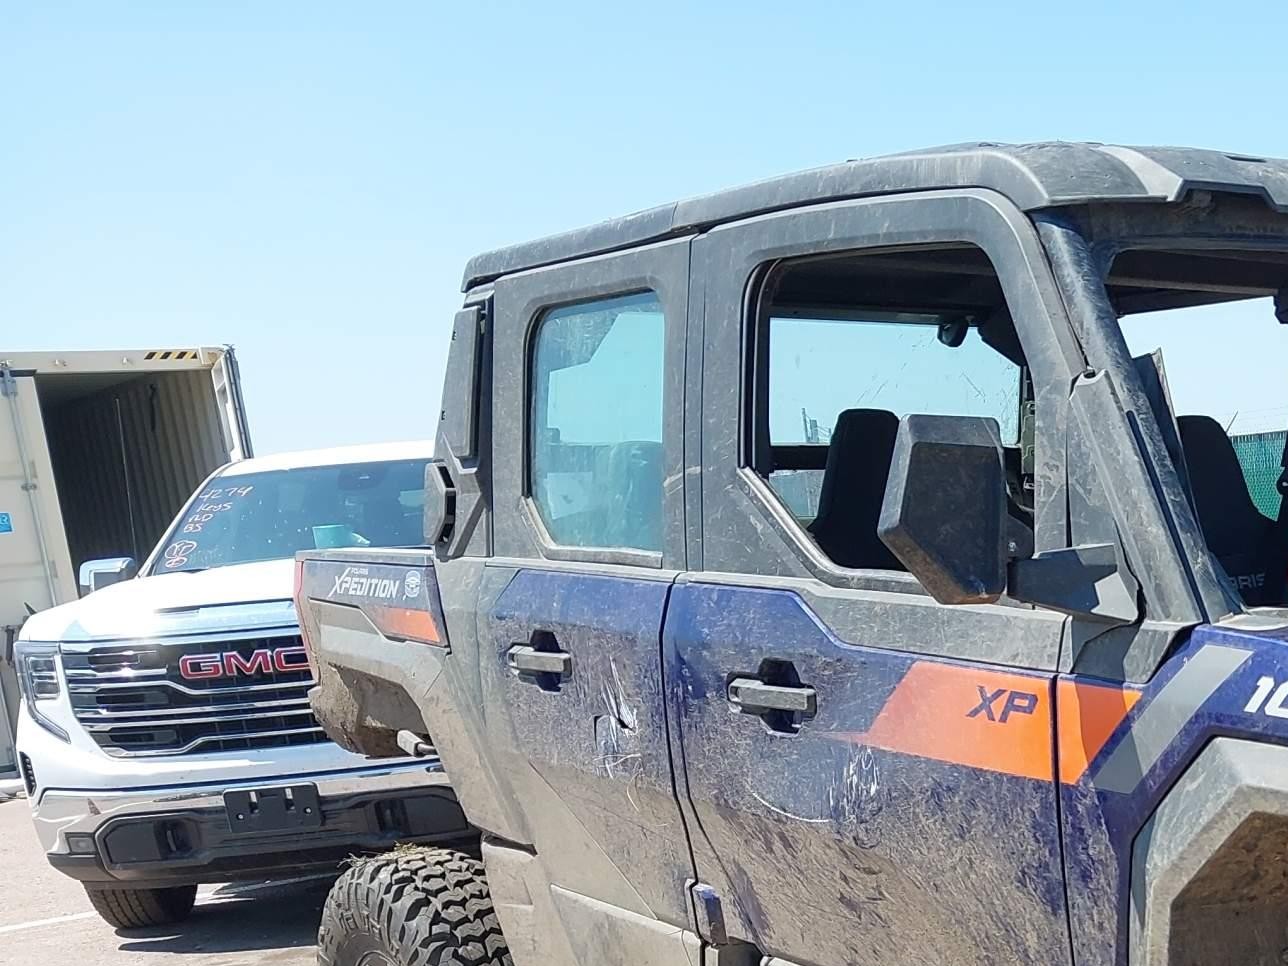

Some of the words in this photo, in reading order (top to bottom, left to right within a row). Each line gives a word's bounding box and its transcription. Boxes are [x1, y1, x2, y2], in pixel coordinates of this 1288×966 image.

[327, 567, 400, 599] XPEDITION
[179, 646, 311, 680] GMC
[965, 684, 1039, 723] XP
